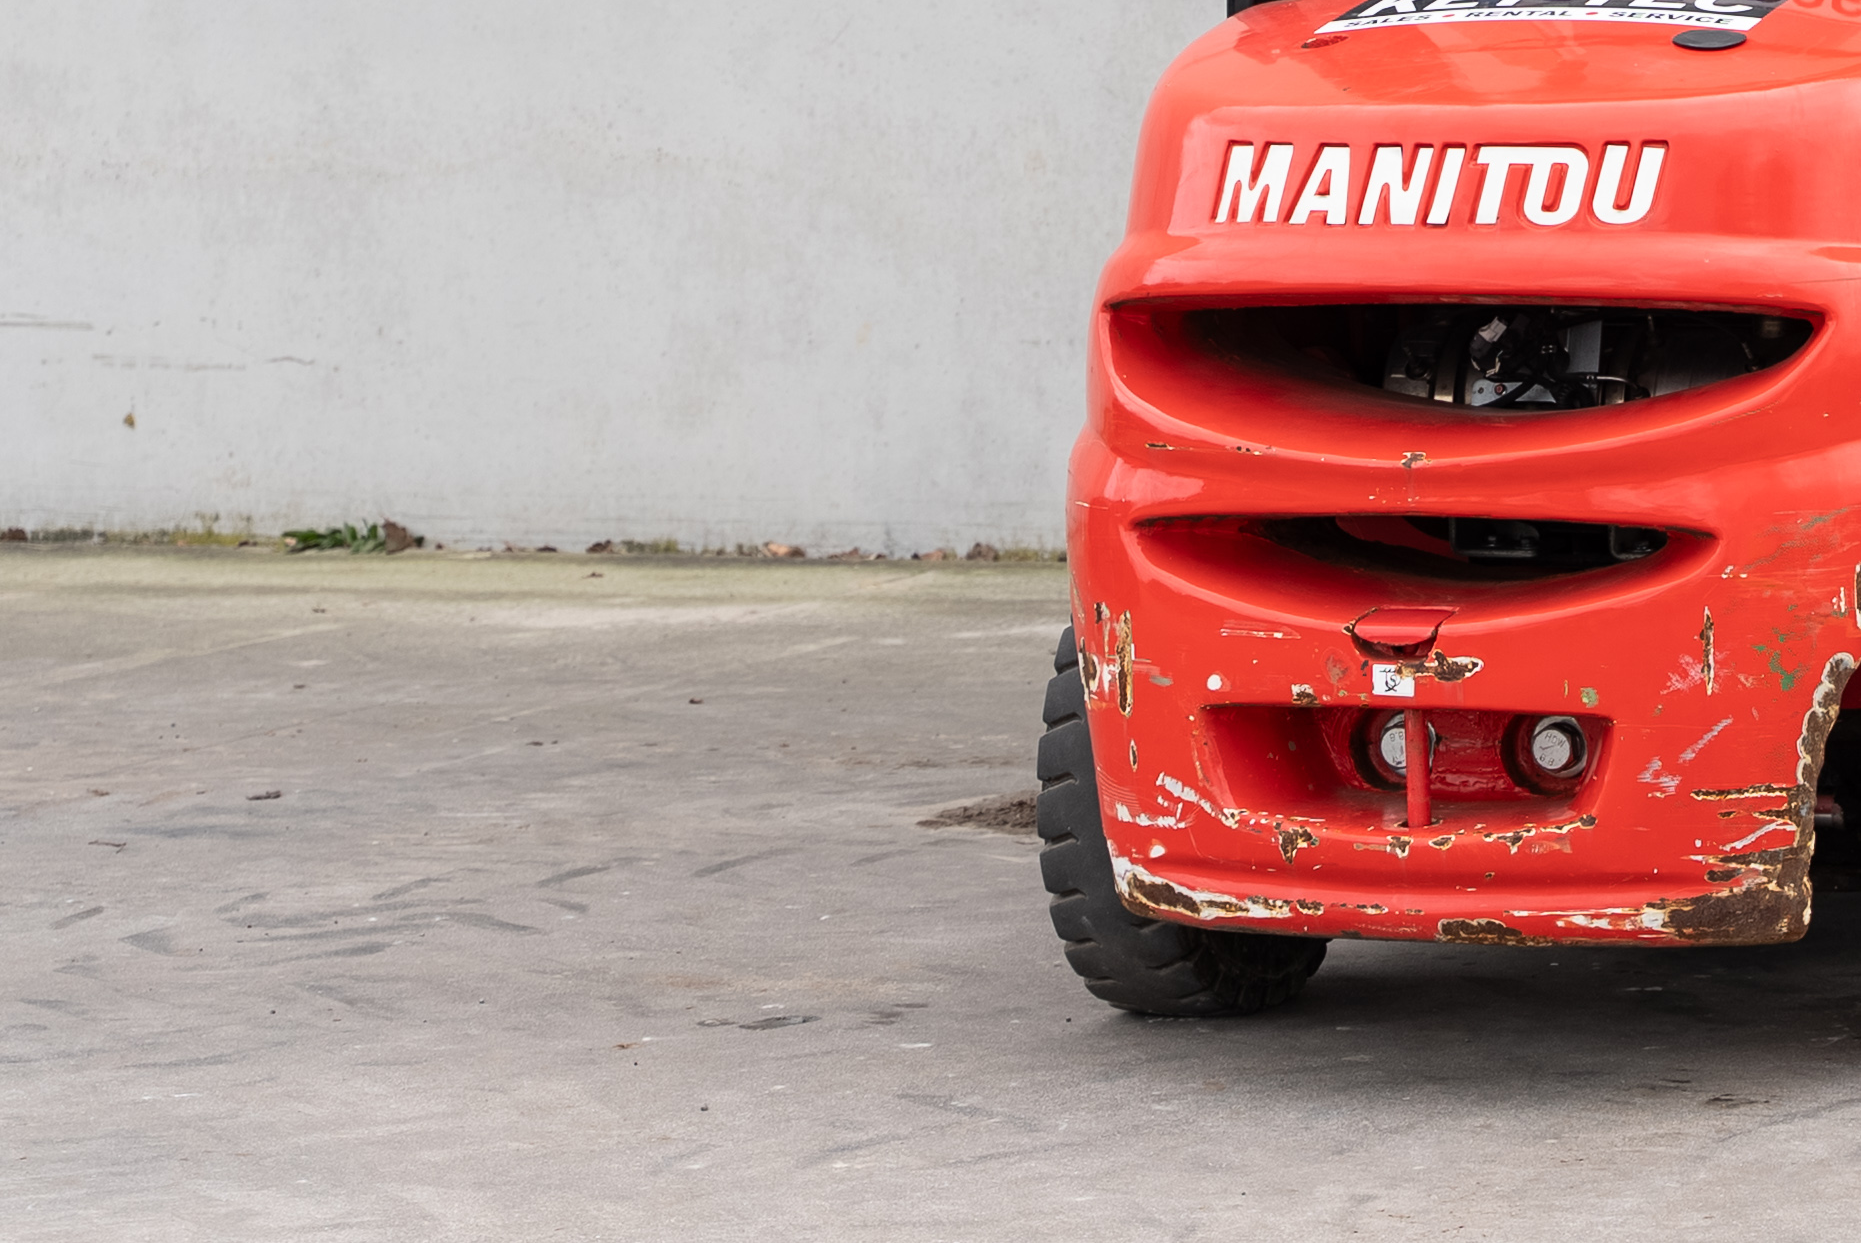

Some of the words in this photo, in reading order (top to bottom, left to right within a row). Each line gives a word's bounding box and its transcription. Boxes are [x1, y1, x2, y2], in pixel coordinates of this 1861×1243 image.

[1343, 13, 1432, 29] SALES
[1465, 9, 1573, 19] RENTAL
[1609, 11, 1733, 27] SERVICE
[1215, 143, 1668, 226] MANITOU
